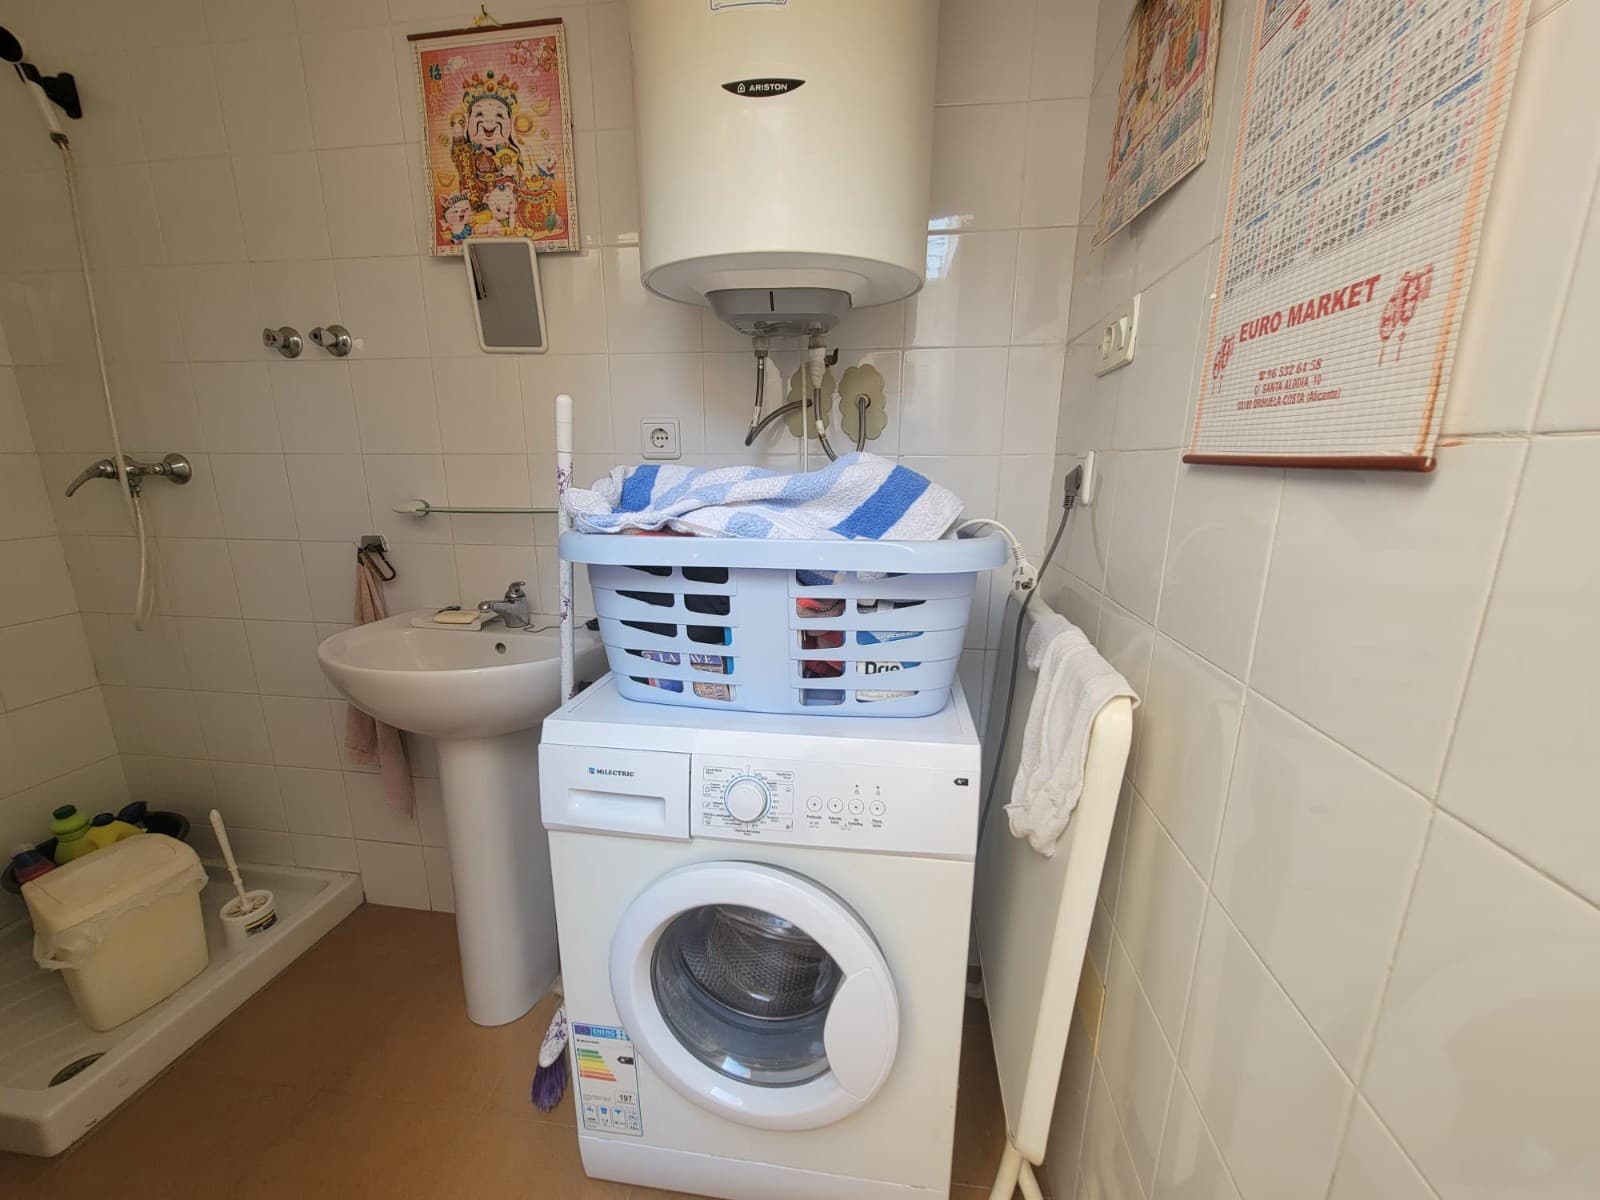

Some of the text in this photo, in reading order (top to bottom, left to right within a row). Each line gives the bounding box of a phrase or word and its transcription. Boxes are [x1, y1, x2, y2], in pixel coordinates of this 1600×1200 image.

[749, 83, 788, 92] ARISTON
[1239, 274, 1382, 343] EURO MARKET
[1267, 368, 1277, 380] 96
[1262, 381, 1283, 395] SANTA
